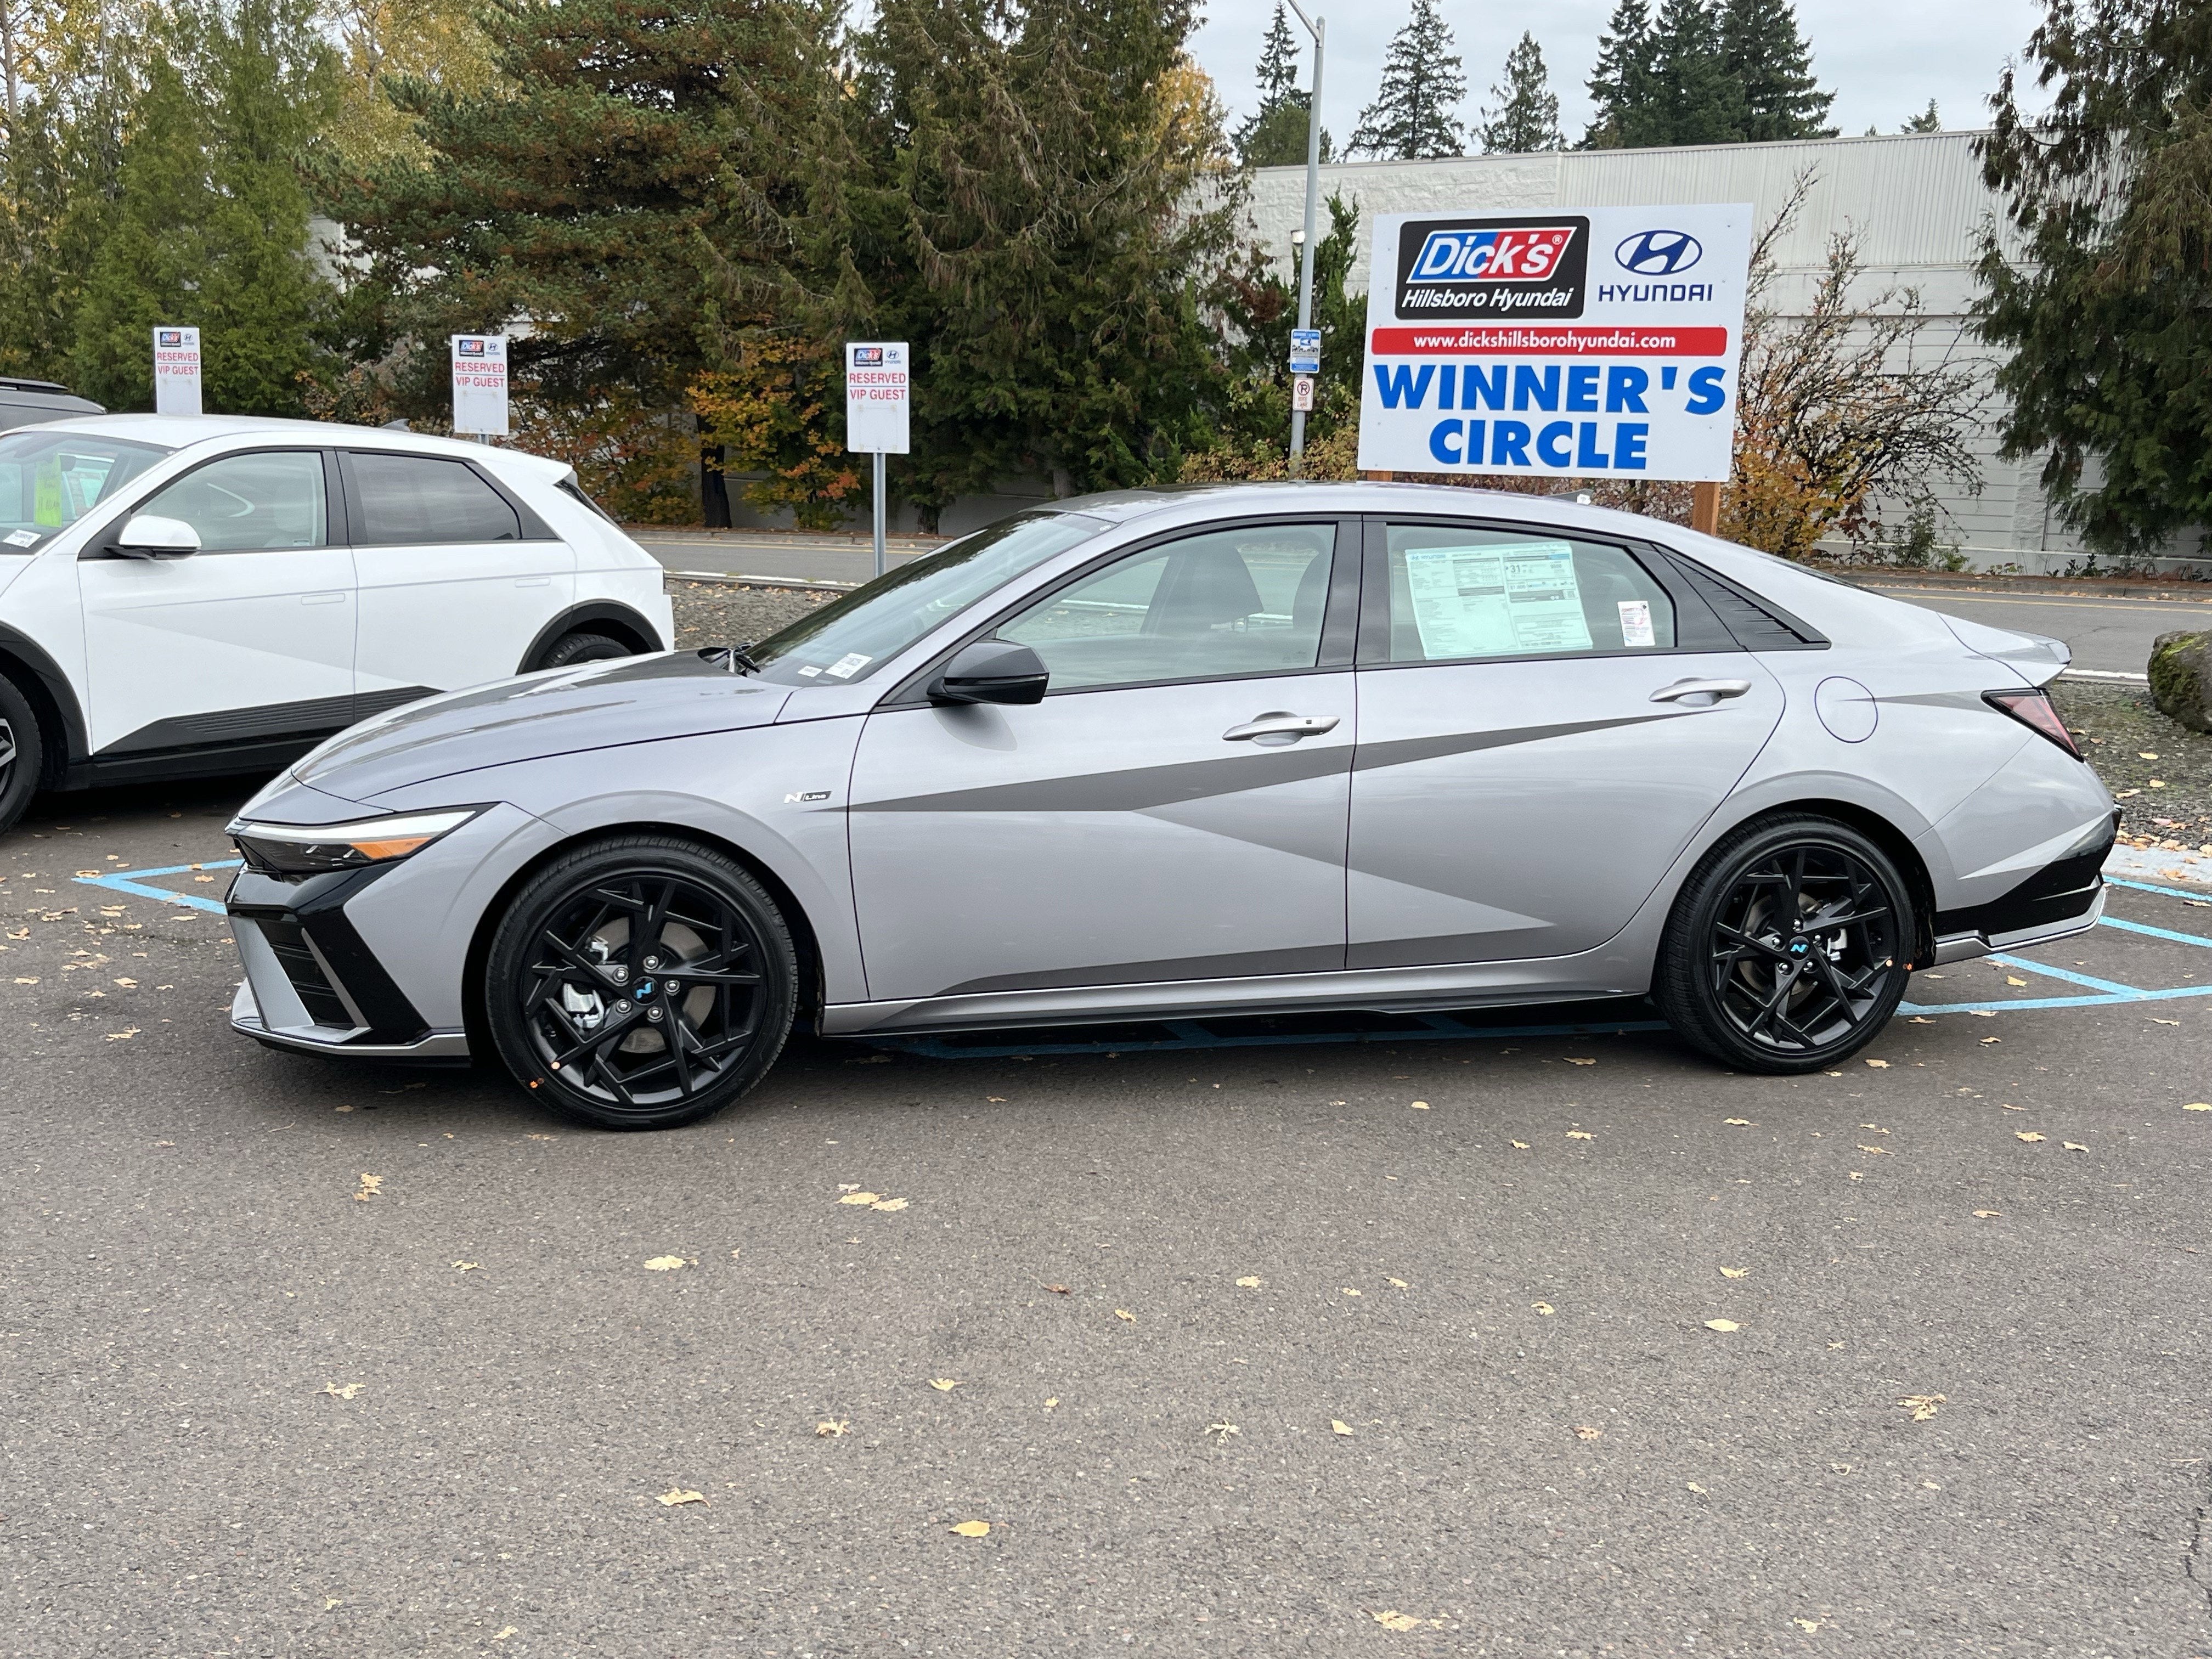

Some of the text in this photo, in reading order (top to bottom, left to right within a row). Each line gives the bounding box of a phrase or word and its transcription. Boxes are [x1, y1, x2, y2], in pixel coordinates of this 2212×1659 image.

[1419, 234, 1554, 276] Dick's
[1401, 287, 1575, 312] Hillsboro Hyundai
[1598, 284, 1713, 302] HYUNDAI
[1413, 330, 1676, 353] www.dickshillsborohyundai.com
[157, 352, 199, 362] RESERVED
[158, 366, 199, 376] VIP GUEST
[455, 362, 505, 373] RESERVED
[456, 376, 505, 387] VIP GUEST
[849, 373, 906, 383] RESERVED
[850, 389, 906, 400] VIP GUEST
[1373, 364, 1726, 415] WINNER'S
[1429, 419, 1649, 470] CIRCLE
